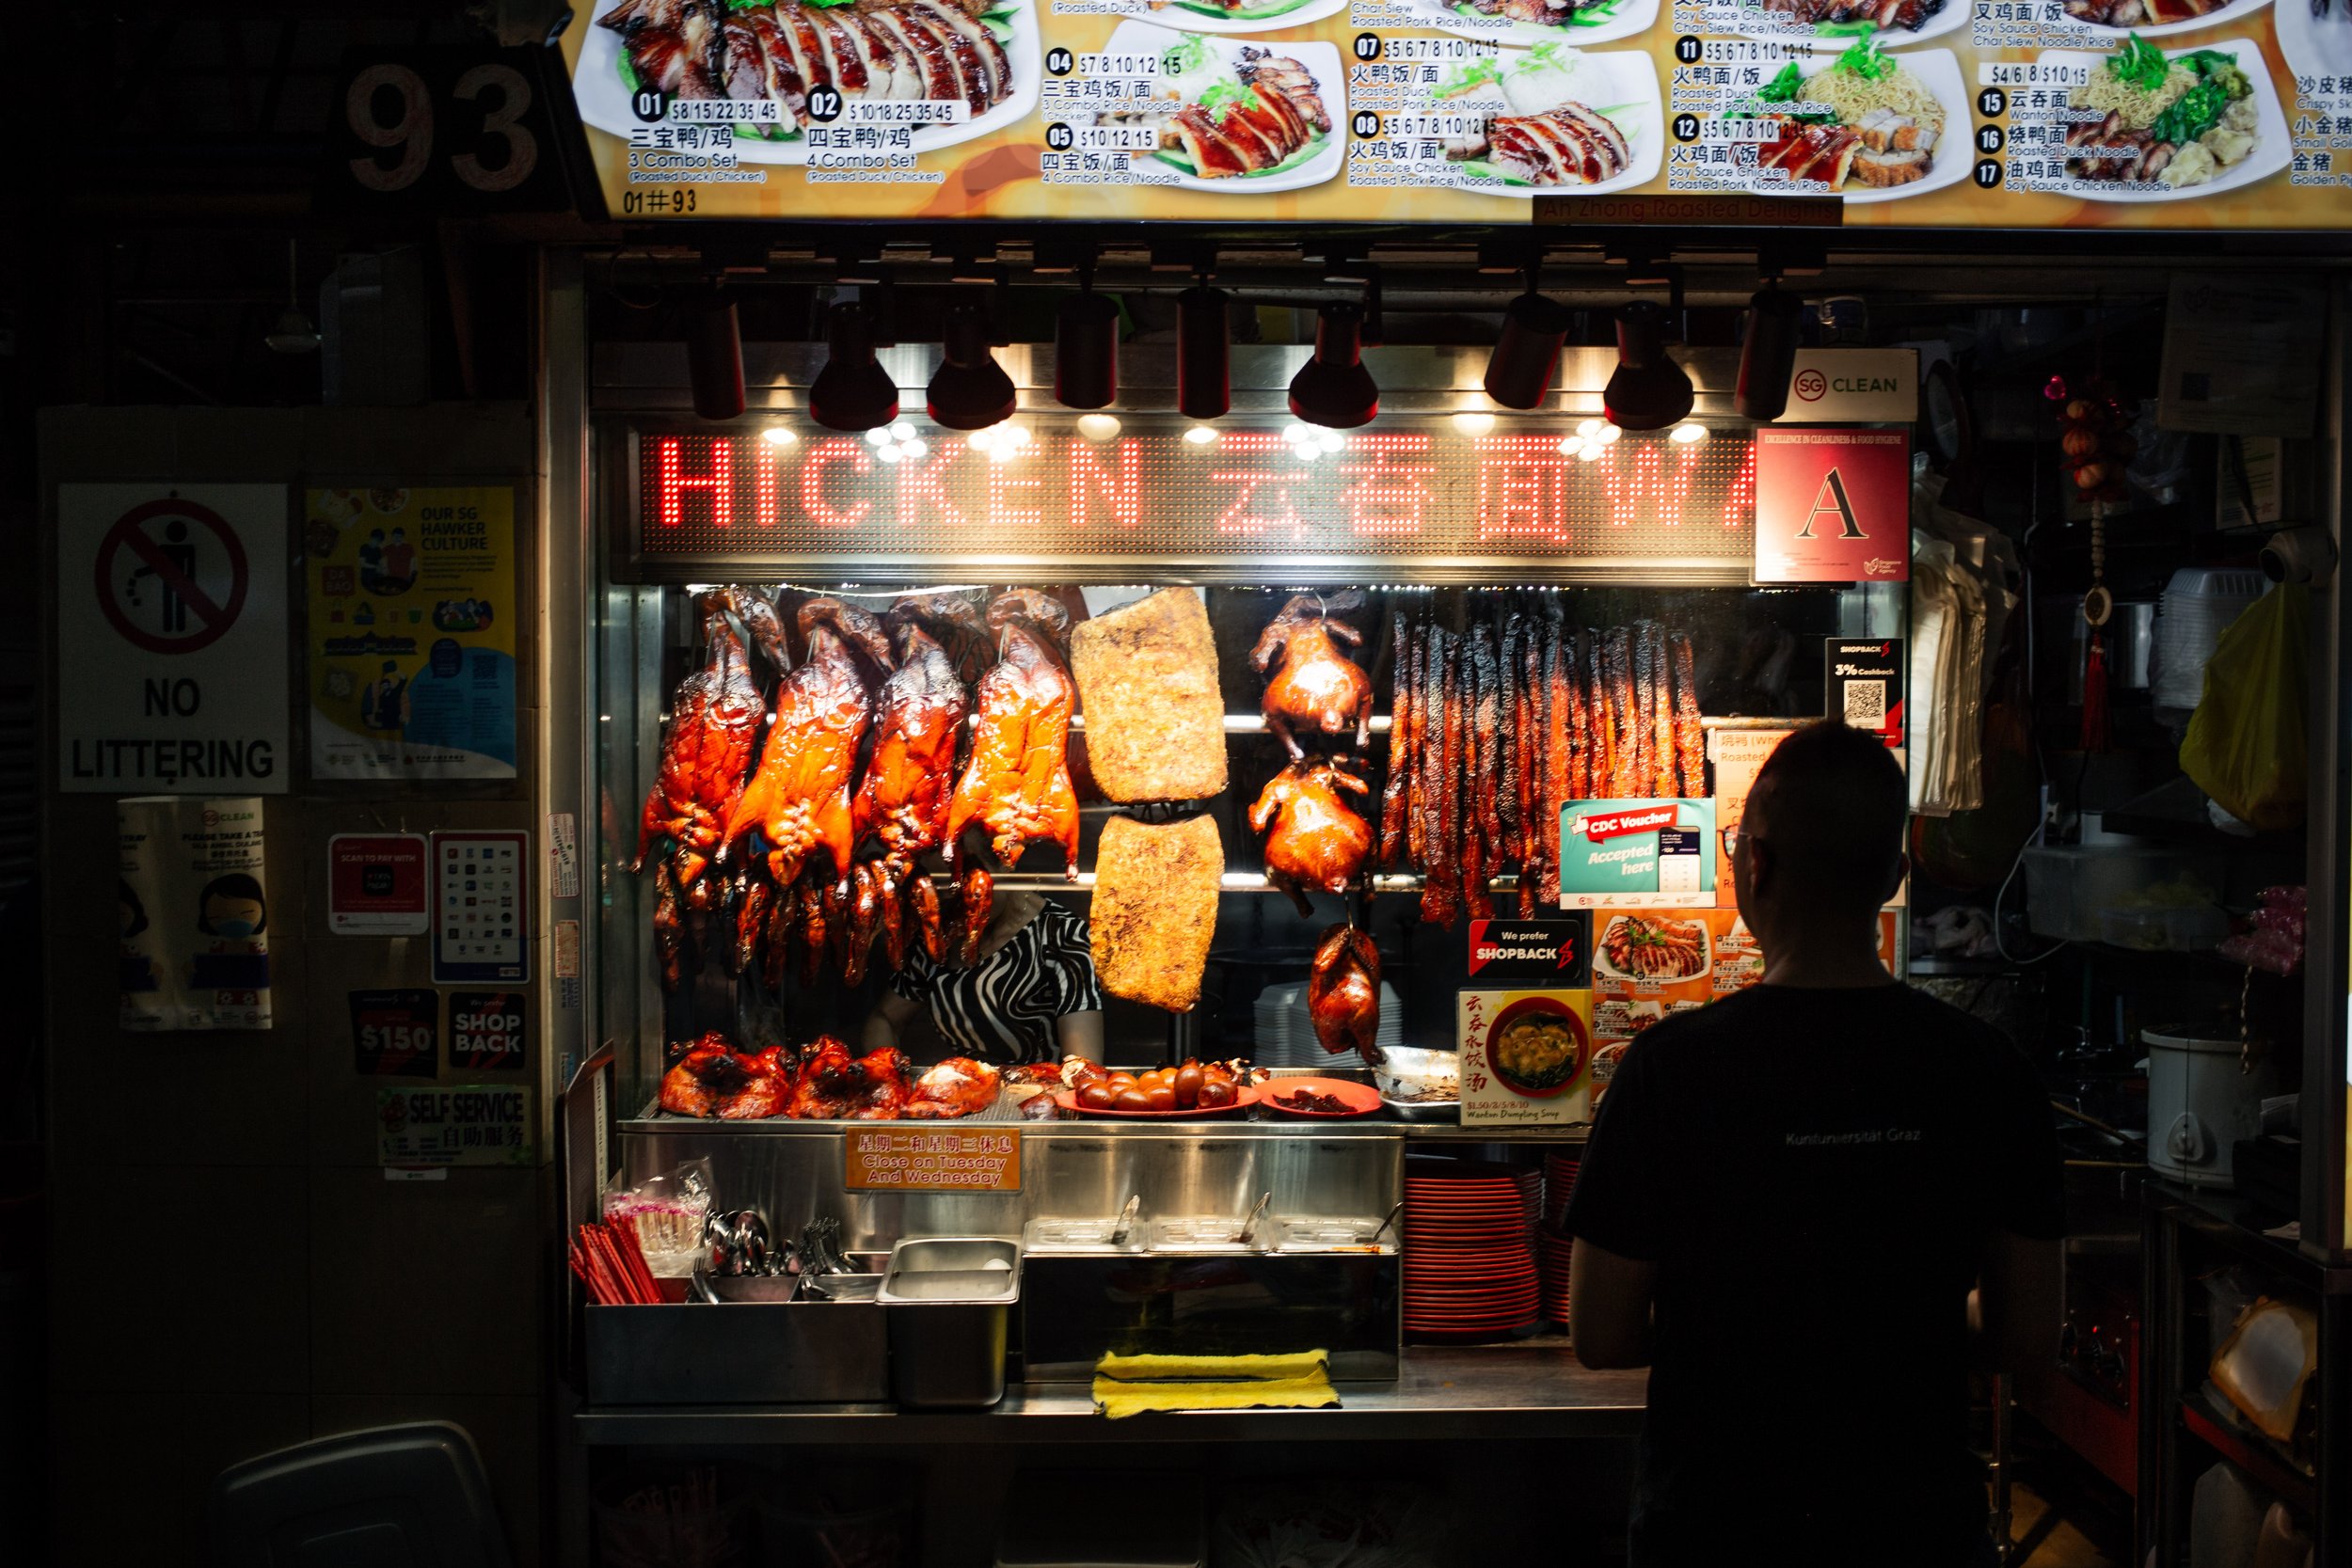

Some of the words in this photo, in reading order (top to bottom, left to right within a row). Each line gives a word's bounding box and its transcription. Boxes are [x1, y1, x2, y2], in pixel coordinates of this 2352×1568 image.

[1052, 3, 1106, 14] (Roasted
[1111, 3, 1147, 14] Duck)
[1352, 3, 1381, 13] Char
[1386, 3, 1413, 13] Siew
[1352, 16, 1402, 27] Roasted
[1406, 16, 1431, 27] Pork
[1437, 16, 1513, 28] Rice/Noodle
[1674, 10, 1695, 21] Soy
[1700, 10, 1738, 21] Sauce
[1742, 10, 1794, 21] Chicken
[1674, 23, 1705, 33] Char
[1708, 23, 1735, 33] Siew
[1740, 23, 1816, 34] Rice/Noodle
[1974, 24, 1994, 35] Soy
[1999, 24, 2037, 34] Sauce
[2042, 24, 2092, 34] Chicken
[1357, 39, 1377, 56] 07
[1973, 36, 2003, 46] Char
[2006, 36, 2032, 46] Siew
[2038, 36, 2115, 48] Noodle/Rice
[1682, 41, 1696, 58] 11
[1049, 54, 1072, 71] 04
[1350, 87, 1400, 97] Roasted
[1402, 87, 1432, 97] Duck
[1673, 88, 1722, 99] Roasted
[1725, 88, 1757, 99] Duck
[639, 93, 661, 115] 01
[811, 93, 837, 115] 02
[1042, 101, 1049, 110] 3
[1054, 100, 1100, 111] Combo
[1350, 100, 1399, 111] Roasted
[1403, 100, 1427, 111] Pork
[1432, 100, 1504, 111] Rice/Noodle
[1984, 94, 2001, 112] 15
[2010, 90, 2068, 109] 云吞面
[2296, 99, 2333, 111] Crispy
[1673, 102, 1721, 112] Roasted
[1725, 102, 1751, 112] Pork
[1756, 102, 1832, 113] Noodle/Rice
[1042, 111, 1094, 122] (Chicken)
[2010, 111, 2055, 121] Wanton
[2058, 111, 2105, 121] Noodle
[345, 62, 538, 193] 93
[1357, 117, 1377, 134] 08
[1677, 119, 1695, 136] 12
[1049, 128, 1071, 146] 05
[1981, 130, 1998, 149] 16
[2009, 126, 2067, 144] 烧鸭面
[2295, 138, 2327, 148] Small
[2009, 147, 2057, 157] Roasted
[2062, 147, 2091, 157] Duck
[2095, 147, 2139, 157] Noodle
[629, 153, 639, 167] 3
[644, 153, 707, 167] Combo
[712, 153, 738, 167] Set
[807, 153, 817, 167] 4
[822, 153, 884, 167] Combo
[890, 153, 916, 167] Set
[2293, 152, 2331, 171] 金猪
[1349, 163, 1371, 175] Soy
[1374, 163, 1414, 173] Sauce
[1415, 163, 1464, 173] Chicken
[1670, 167, 1692, 178] Soy
[1695, 166, 1733, 177] Sauce
[1738, 166, 1788, 177] Chicken
[1979, 166, 1996, 182] 17
[2006, 161, 2064, 179] 油鸡面
[629, 171, 677, 182] (Roasted
[806, 171, 855, 182] (Roasted
[1042, 173, 1050, 183] 4
[1054, 173, 1100, 183] Combo
[1349, 176, 1399, 186] Roasted
[1401, 176, 1425, 186] Pork
[1430, 176, 1503, 187] Rice/Noodle
[2291, 174, 2335, 185] Golden
[1670, 180, 1718, 191] Roasted
[1723, 180, 1748, 191] Pork
[1753, 180, 1829, 192] Noodle/Rice
[2006, 182, 2028, 193] Soy
[2031, 182, 2068, 192] Sauce
[2073, 182, 2123, 192] Chicken
[2126, 182, 2170, 192] Noodle
[1545, 199, 1570, 218] Ah
[1580, 199, 1644, 222] Zhong
[1653, 199, 1740, 218] Roasted
[1748, 200, 1834, 223] Delights
[1833, 378, 1898, 392] CLEAN
[1794, 467, 1869, 539] A
[422, 507, 453, 520] OUR
[458, 507, 478, 520] SG
[421, 522, 485, 535] HAWKER
[421, 537, 488, 550] CULTURE
[1836, 664, 1858, 675] 3%
[145, 678, 201, 717] NO
[72, 740, 274, 779] LITTERING
[1590, 818, 1617, 833] CDC
[1621, 811, 1672, 829] Voucher
[1588, 843, 1654, 864] Accepted
[1622, 862, 1654, 876] here
[1502, 932, 1518, 941] We
[1519, 931, 1549, 942] prefer
[1476, 948, 1557, 960] SHOPBACK
[455, 1013, 521, 1032] SHOP
[455, 1035, 521, 1053] BACK
[410, 1094, 450, 1123] SELF
[453, 1093, 524, 1123] SERVICE
[1500, 1110, 1539, 1120] Dumpling
[1541, 1108, 1560, 1120] Soup
[443, 1126, 523, 1148] 自助服务
[858, 1134, 1013, 1153] 星期二和星期三休息
[862, 1154, 909, 1169] Close
[914, 1156, 934, 1168] on
[939, 1155, 1007, 1171] Tuesday
[866, 1170, 902, 1183] And
[906, 1170, 1002, 1187] Wednesday
